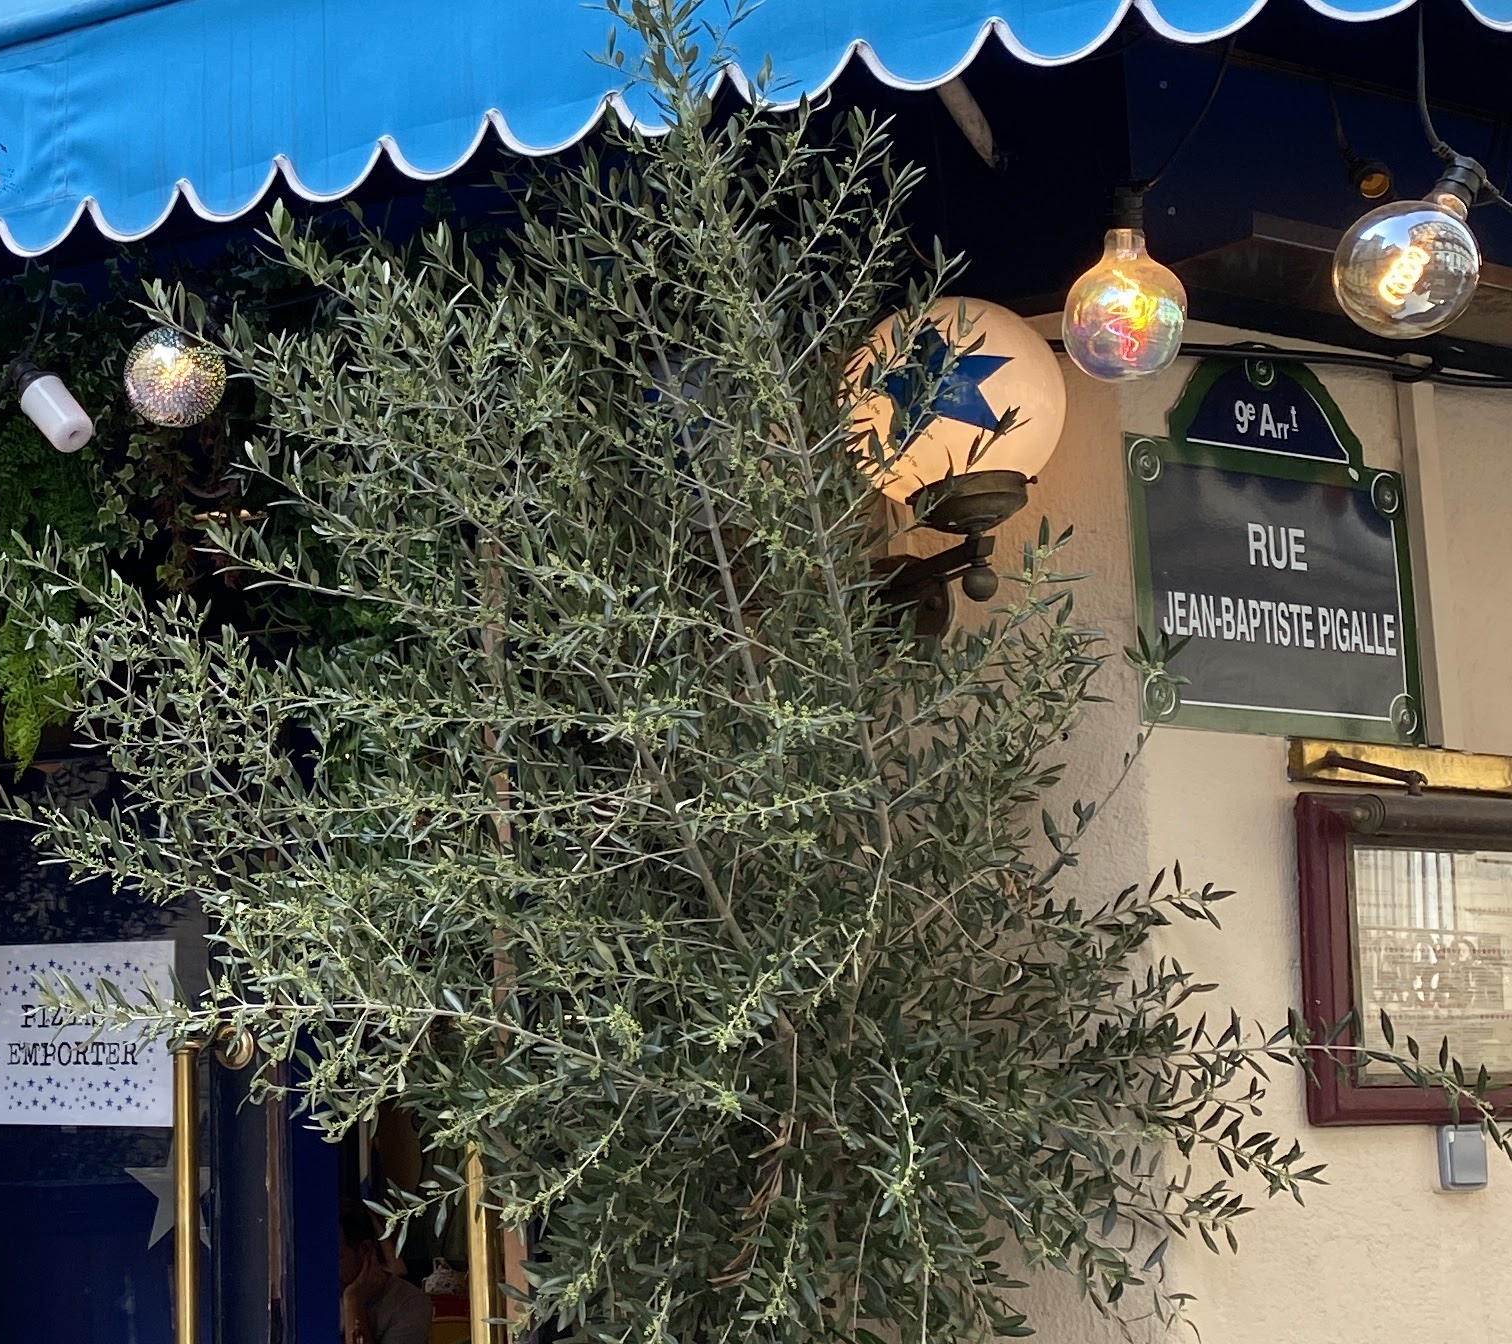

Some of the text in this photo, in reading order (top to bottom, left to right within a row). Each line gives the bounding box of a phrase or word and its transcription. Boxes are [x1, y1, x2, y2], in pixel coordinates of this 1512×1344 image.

[1246, 522, 1309, 572] RUE
[1162, 590, 1397, 657] JEAN-BAPTISTE PIGALLE
[7, 1042, 139, 1067] EMPORTER
